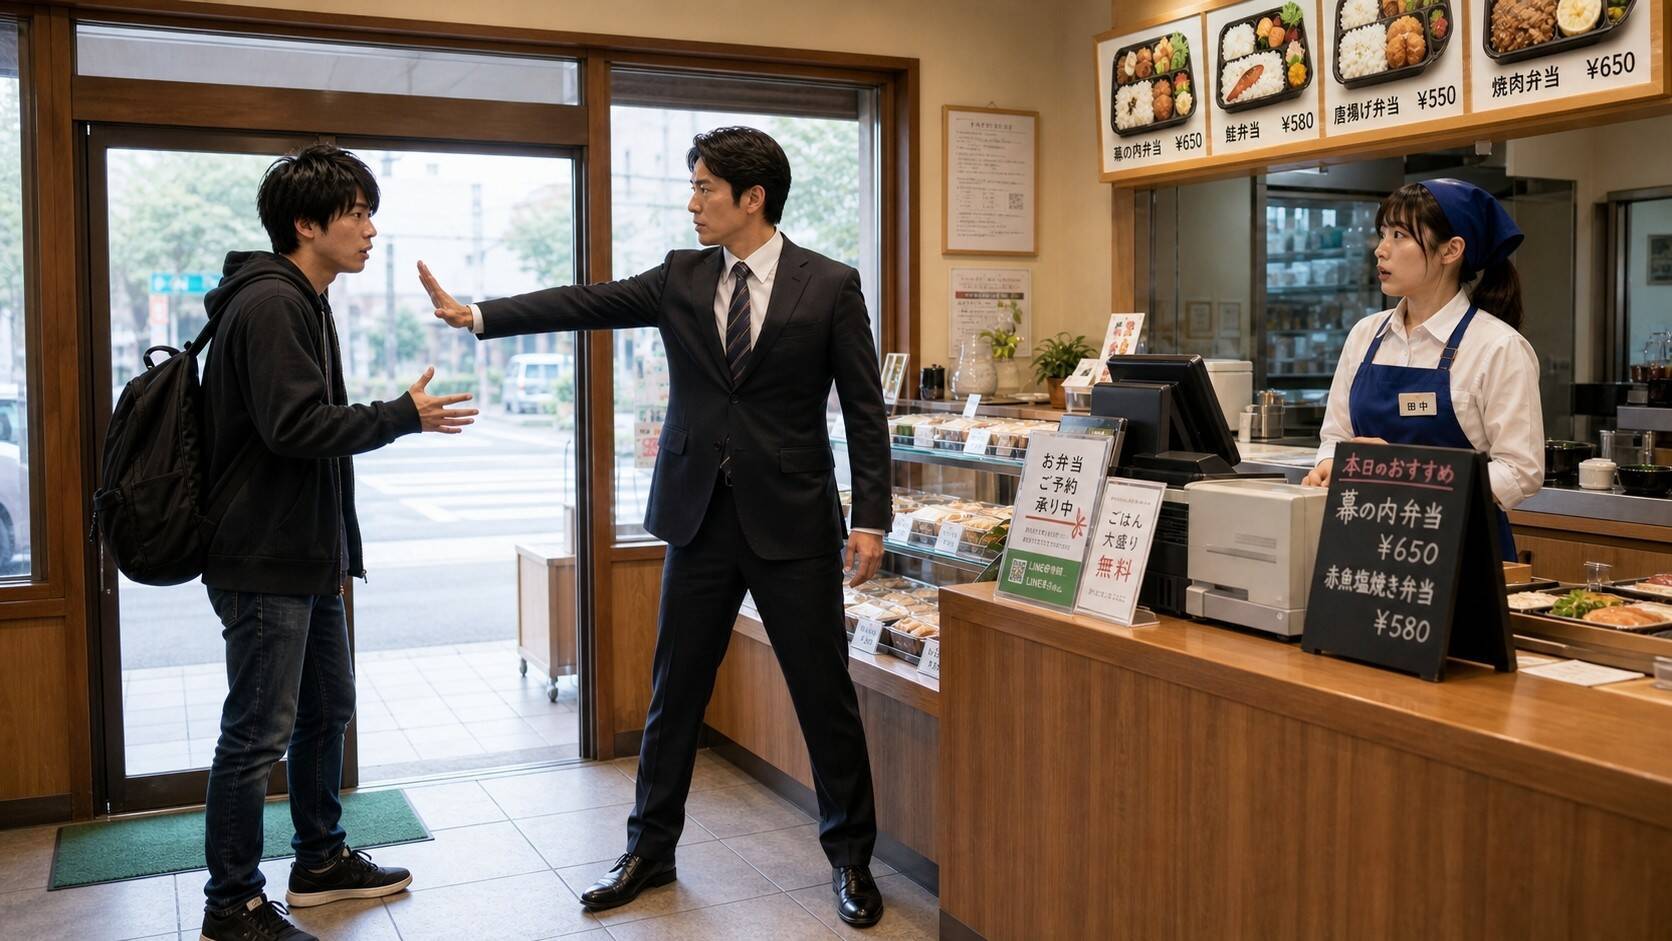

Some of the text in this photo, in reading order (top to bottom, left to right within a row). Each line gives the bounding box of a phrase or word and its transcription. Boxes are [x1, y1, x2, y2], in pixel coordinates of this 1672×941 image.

[1492, 51, 1636, 98] 焼肉弁当 ¥650
[1417, 85, 1456, 110] ¥550
[1225, 111, 1314, 143] 鮭弁当 ¥580
[1175, 132, 1203, 152] ¥650
[1407, 400, 1428, 412] 田中
[1042, 452, 1084, 473] お弁当
[1342, 452, 1455, 485] 本日のおすすめ
[1040, 475, 1078, 495] ご予約
[1035, 496, 1073, 517] 承り中
[1108, 511, 1143, 529] ごはん
[1335, 488, 1443, 530] 幕の内弁当
[1102, 532, 1138, 552] 大盛り
[1377, 533, 1440, 566] ¥650
[1095, 554, 1132, 583] 無料
[1324, 564, 1435, 606] 赤魚塩焼き弁当
[1373, 608, 1431, 644] ¥580
